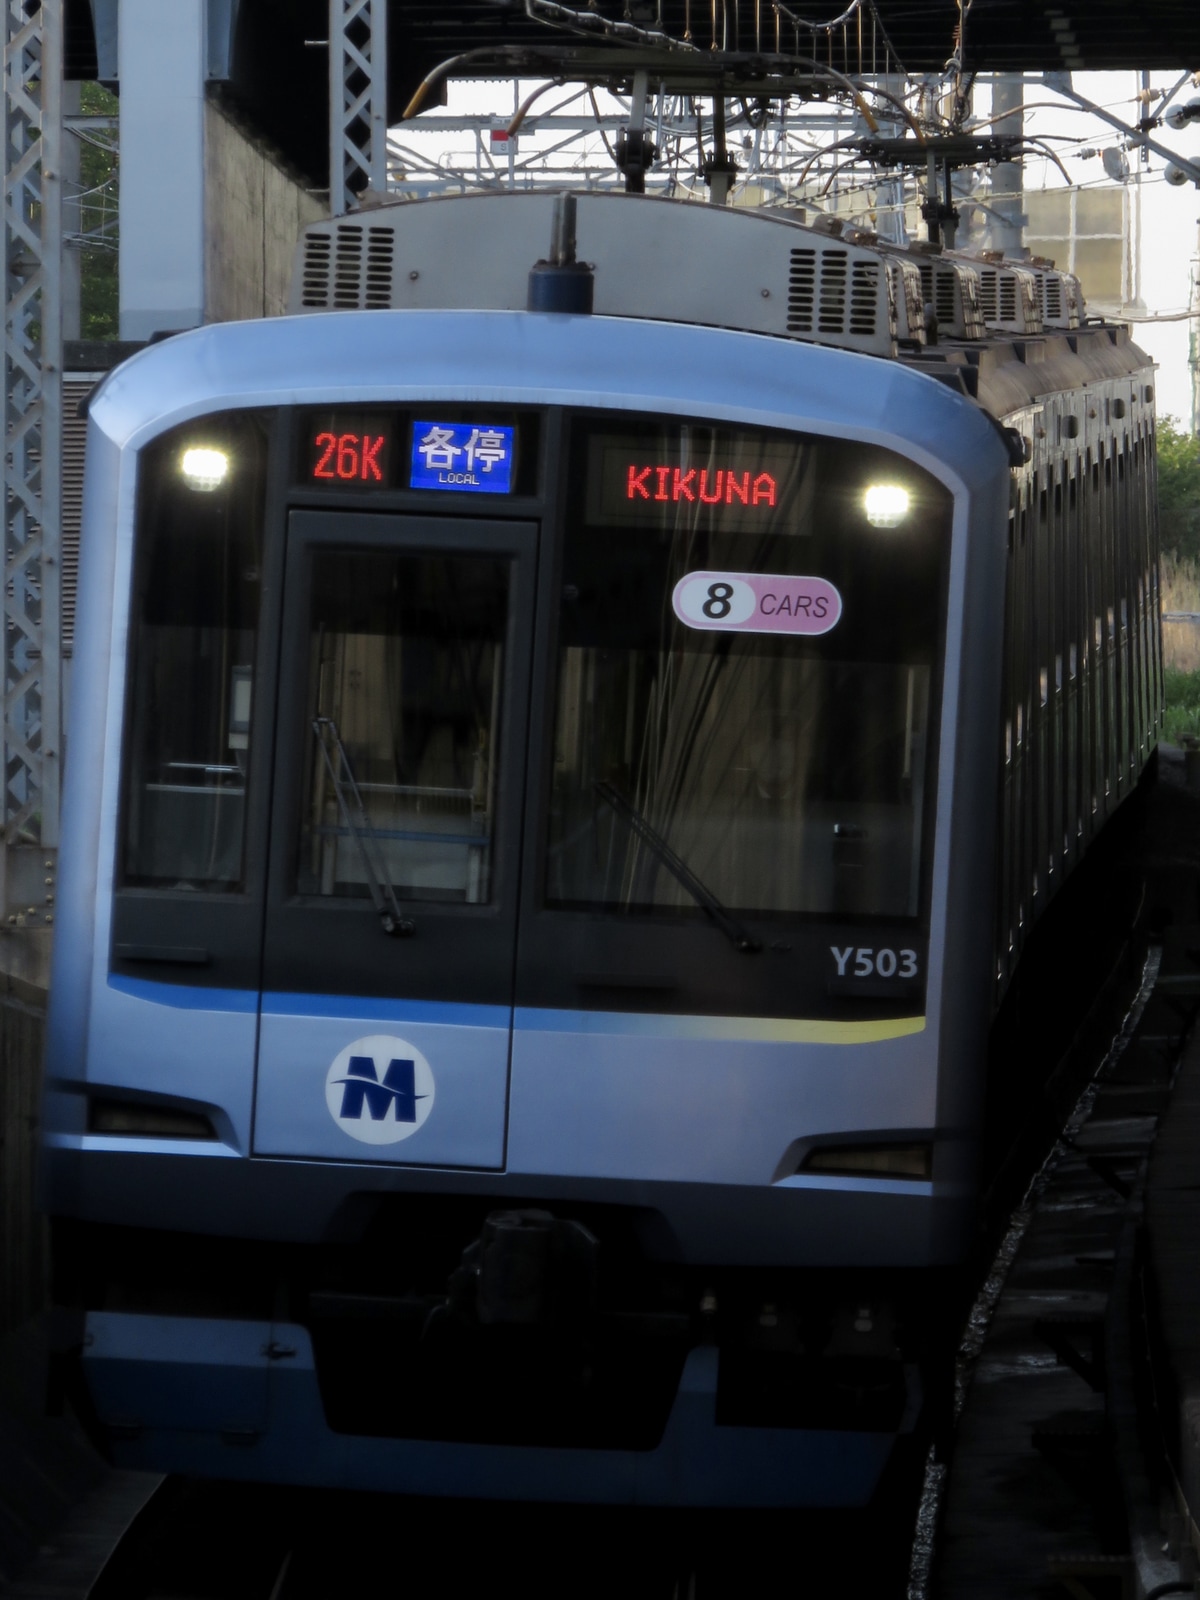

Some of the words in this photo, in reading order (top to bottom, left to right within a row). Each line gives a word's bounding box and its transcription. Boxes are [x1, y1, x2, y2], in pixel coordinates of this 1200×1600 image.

[313, 432, 385, 481] 26K
[418, 426, 506, 473] 各停
[438, 472, 480, 485] LOCAL
[627, 465, 776, 506] KIKUNA
[702, 582, 734, 619] 8
[759, 593, 829, 618] CARS
[830, 946, 918, 978] Y503
